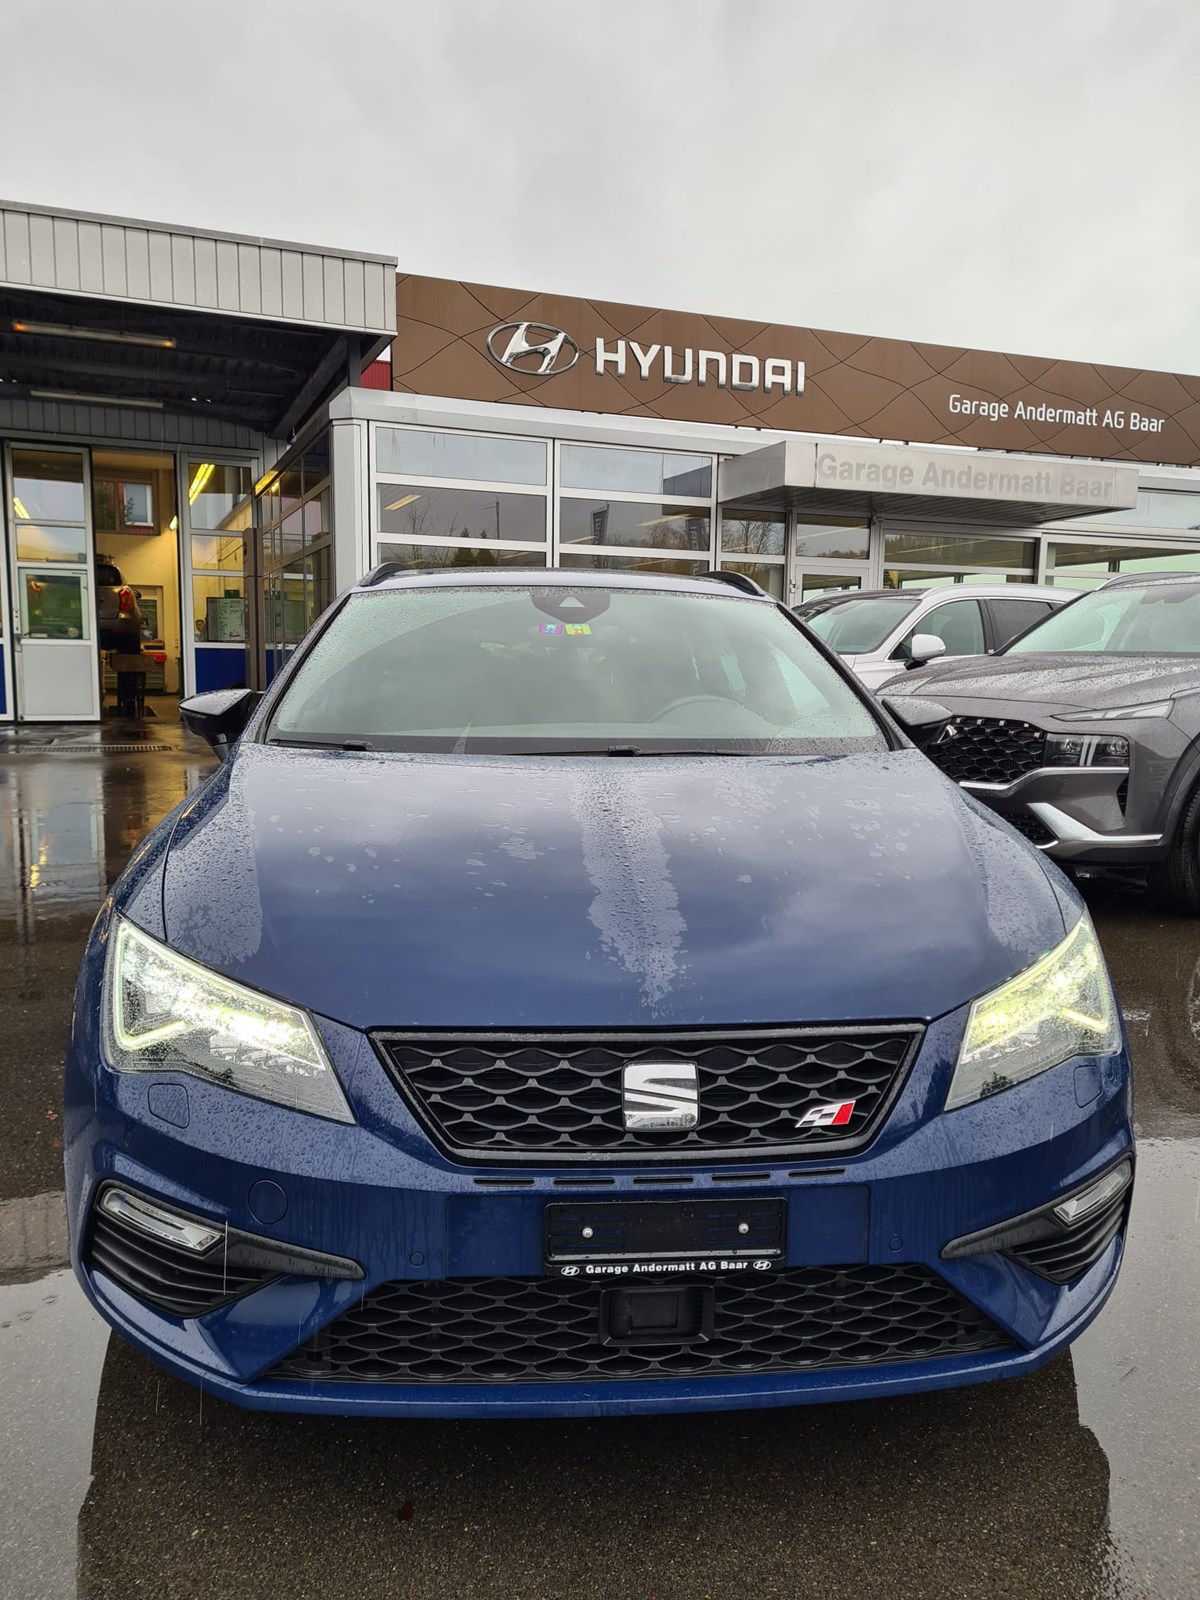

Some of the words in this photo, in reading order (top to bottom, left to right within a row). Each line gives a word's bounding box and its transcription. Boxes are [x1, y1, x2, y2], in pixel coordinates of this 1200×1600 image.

[595, 337, 805, 396] HYUNDAI
[949, 394, 1009, 421] Garage
[1014, 401, 1098, 426] Andermatt
[1102, 409, 1125, 429] AG
[1129, 412, 1165, 432] Baar
[817, 453, 914, 489] Garage
[921, 461, 1051, 495] Andermatt
[1059, 473, 1113, 499] Baar
[585, 1264, 629, 1275] Garage
[632, 1262, 696, 1273] Andermatt
[699, 1261, 717, 1271] AG
[720, 1260, 748, 1270] Baar
